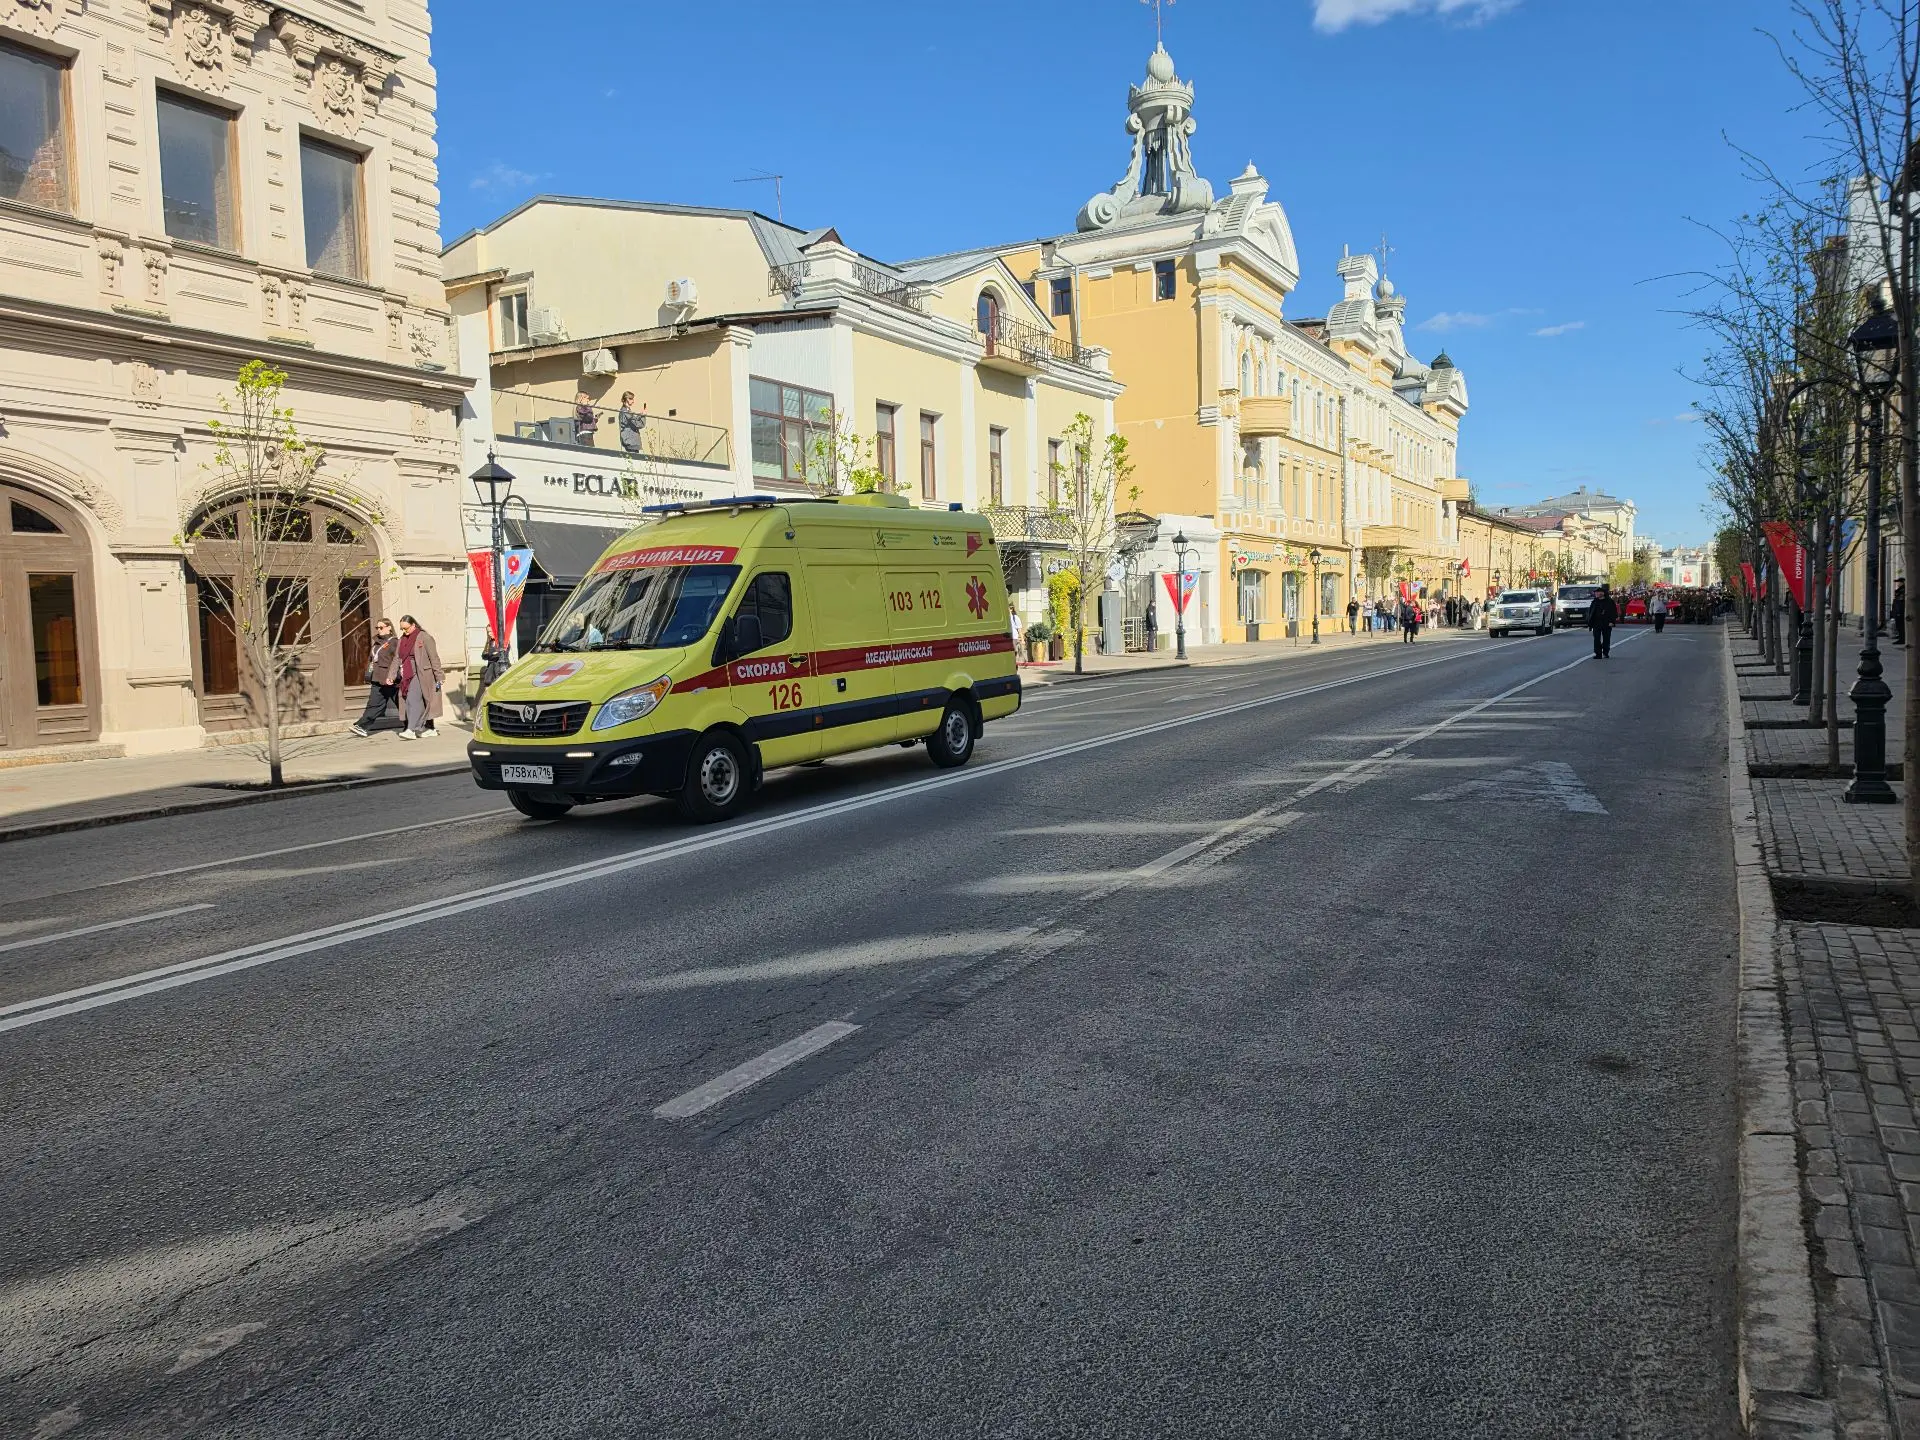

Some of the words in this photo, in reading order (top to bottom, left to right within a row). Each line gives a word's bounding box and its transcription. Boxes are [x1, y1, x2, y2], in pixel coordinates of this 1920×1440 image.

[607, 550, 725, 570] РЕАНИМАЦИЯ
[889, 591, 914, 612] 103
[920, 590, 941, 609] 112
[737, 661, 786, 678] СКОРАЯ
[865, 646, 933, 664] МЕДИЦИНСКАЯ
[957, 639, 991, 653] ПОМОЩЬ
[768, 682, 802, 710] 126
